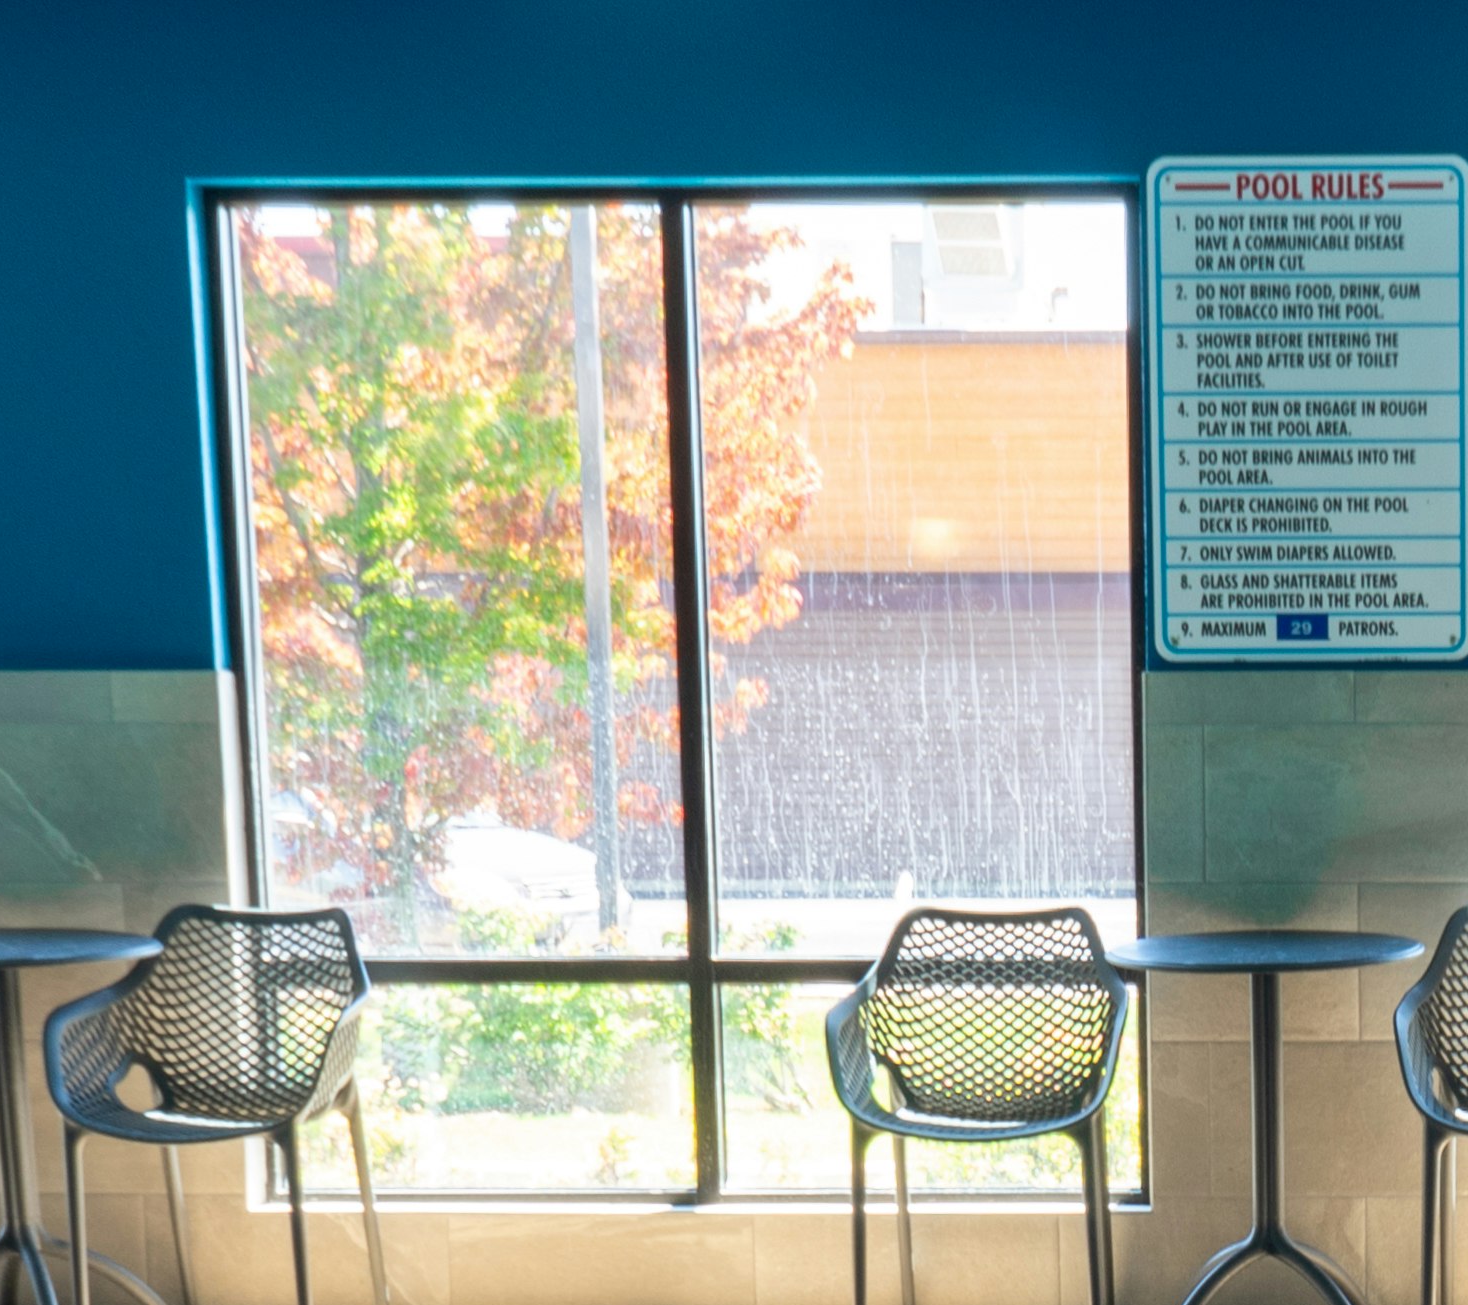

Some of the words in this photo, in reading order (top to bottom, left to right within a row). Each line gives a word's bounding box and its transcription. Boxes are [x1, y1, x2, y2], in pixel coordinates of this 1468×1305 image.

[1237, 174, 1302, 200] POOL
[1312, 174, 1384, 200] RULES
[1175, 215, 1187, 230] 1.
[1194, 215, 1215, 231] DO
[1218, 215, 1245, 230] NOT
[1248, 214, 1289, 230] ENTER
[1292, 214, 1316, 230] THE
[1320, 214, 1356, 230] POOL
[1359, 214, 1371, 230] IF
[1373, 214, 1402, 230] YOU
[1194, 235, 1229, 250] HAVE
[1232, 235, 1242, 250] A
[1244, 234, 1350, 250] COMMUNICABLE
[1354, 234, 1405, 250] DISEASE
[1194, 255, 1214, 271] OR
[1217, 255, 1236, 270] AN
[1239, 255, 1275, 271] OPEN
[1278, 254, 1306, 270] CUT.
[1175, 284, 1188, 300] 2.
[1195, 283, 1216, 300] DO
[1219, 283, 1246, 300] NOT
[1249, 283, 1292, 300] BRING
[1295, 283, 1336, 302] FOOD,
[1339, 283, 1385, 301] DRINK,
[1388, 283, 1421, 299] GUM
[1195, 303, 1215, 320] OR
[1217, 303, 1279, 320] TOBACCO
[1282, 303, 1314, 319] INTO
[1317, 303, 1342, 319] THE
[1345, 303, 1385, 319] POOL.
[1176, 333, 1188, 348] 3.
[1196, 332, 1252, 348] SHOWER
[1255, 332, 1304, 348] BEFORE
[1307, 332, 1372, 348] ENTERING
[1375, 332, 1399, 348] THE
[1196, 352, 1232, 368] POOL
[1234, 352, 1264, 368] AND
[1266, 352, 1305, 368] AFTER
[1308, 352, 1332, 368] USE
[1335, 351, 1353, 368] OF
[1356, 351, 1399, 368] TOILET
[1196, 372, 1266, 388] FACILITIES.
[1177, 401, 1189, 416] 4.
[1197, 401, 1218, 417] DO
[1220, 401, 1248, 417] NOT
[1251, 401, 1279, 416] RUN
[1282, 401, 1302, 416] OR
[1305, 400, 1357, 416] ENGAGE
[1361, 401, 1376, 416] IN
[1379, 400, 1428, 416] ROUGH
[1198, 421, 1227, 436] PLAY
[1231, 421, 1245, 436] IN
[1250, 420, 1273, 436] THE
[1277, 420, 1312, 436] POOL
[1316, 420, 1351, 436] AREA.
[1178, 449, 1190, 465] 5.
[1198, 449, 1218, 465] DO
[1221, 449, 1249, 465] NOT
[1251, 449, 1294, 465] BRING
[1297, 449, 1354, 464] ANIMALS
[1357, 449, 1389, 464] INTO
[1392, 448, 1416, 464] THE
[1198, 469, 1234, 485] POOL
[1236, 469, 1273, 484] AREA.
[1178, 498, 1191, 513] 6.
[1198, 497, 1245, 513] DIAPER
[1248, 497, 1319, 513] CHANGING
[1322, 497, 1343, 512] ON
[1346, 497, 1370, 512] THE
[1374, 497, 1409, 512] POOL
[1199, 517, 1233, 532] DECK
[1236, 517, 1248, 532] IS
[1251, 517, 1332, 532] PROHIBITED.
[1180, 545, 1192, 560] 7.
[1199, 545, 1233, 561] ONLY
[1236, 545, 1273, 561] SWIM
[1276, 545, 1329, 560] DIAPERS
[1332, 545, 1396, 560] ALLOWED.
[1180, 573, 1192, 589] 8.
[1200, 573, 1239, 589] GLASS
[1241, 573, 1270, 589] AND
[1273, 573, 1357, 588] SHATTERABLE
[1360, 573, 1398, 588] ITEMS
[1200, 593, 1224, 608] ARE
[1227, 593, 1305, 608] PROHIBITED
[1309, 593, 1323, 608] IN
[1327, 592, 1351, 608] THE
[1354, 592, 1389, 608] POOL
[1393, 592, 1429, 608] AREA.
[1181, 621, 1193, 636] 9.
[1201, 621, 1267, 636] MAXIMUM
[1290, 620, 1312, 636] 29
[1338, 621, 1399, 636] PATRONS.
